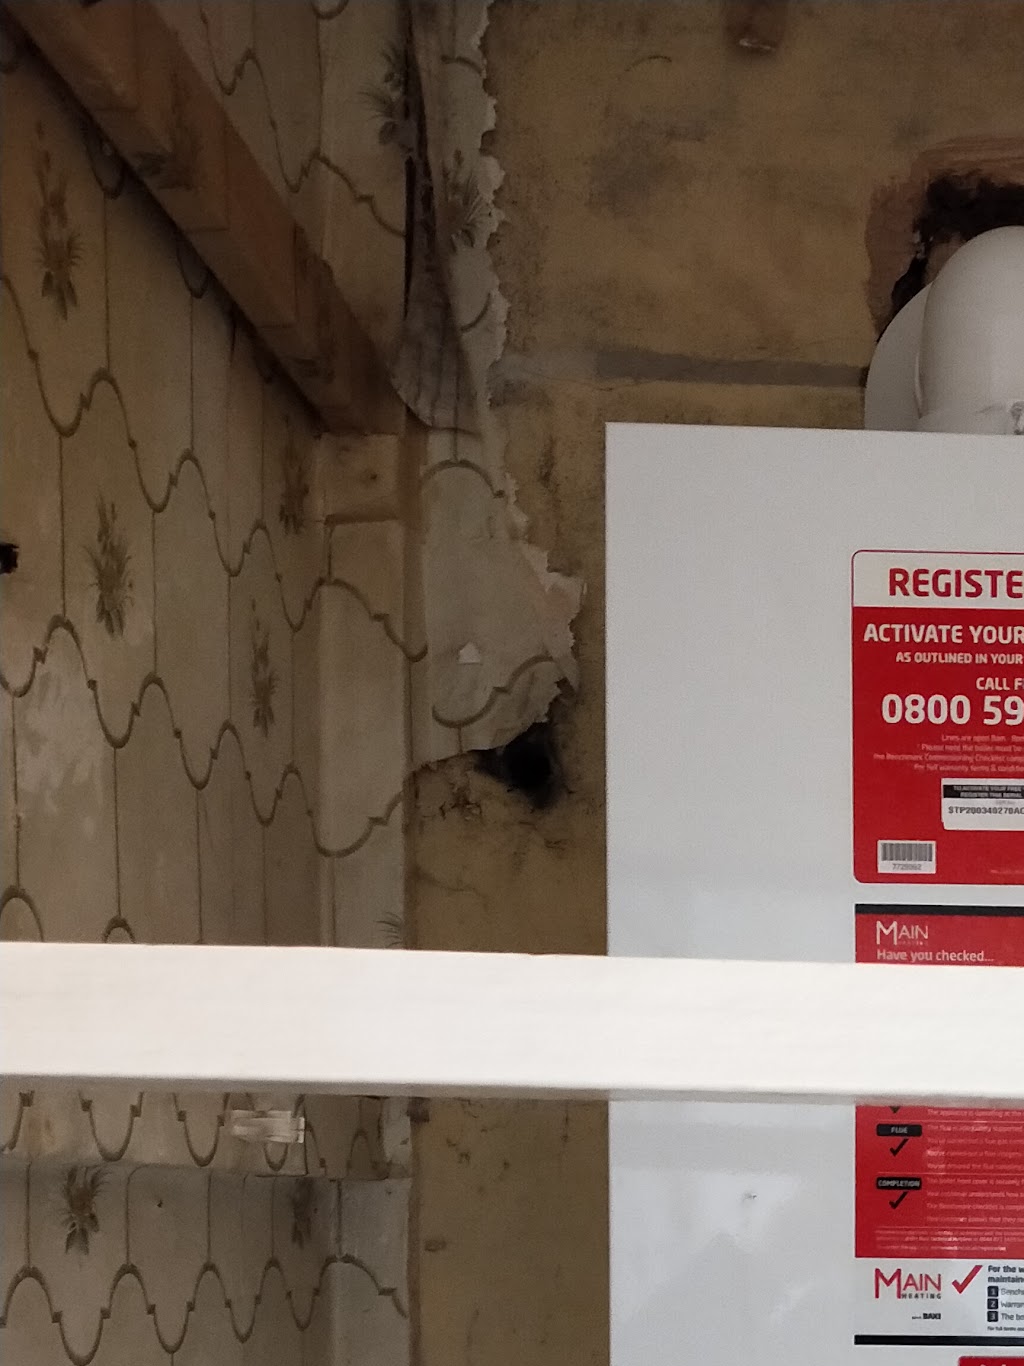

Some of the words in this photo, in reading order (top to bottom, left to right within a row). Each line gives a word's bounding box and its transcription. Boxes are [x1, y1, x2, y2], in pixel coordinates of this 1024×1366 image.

[863, 623, 962, 644] ACTIVATE
[896, 652, 911, 662] AS
[914, 653, 972, 664] OUTLINED
[976, 654, 988, 664] IN
[991, 654, 1023, 665] YOUR
[976, 677, 1010, 690] CALL
[881, 693, 970, 724] 0800
[876, 920, 928, 945] MAIN
[877, 949, 907, 960] Have
[910, 951, 933, 963] you
[890, 1126, 908, 1134] FLUE
[878, 1180, 920, 1188] COMPLETION
[988, 1265, 1001, 1273] For
[1003, 1265, 1016, 1273] the
[875, 1267, 941, 1299] MAIN
